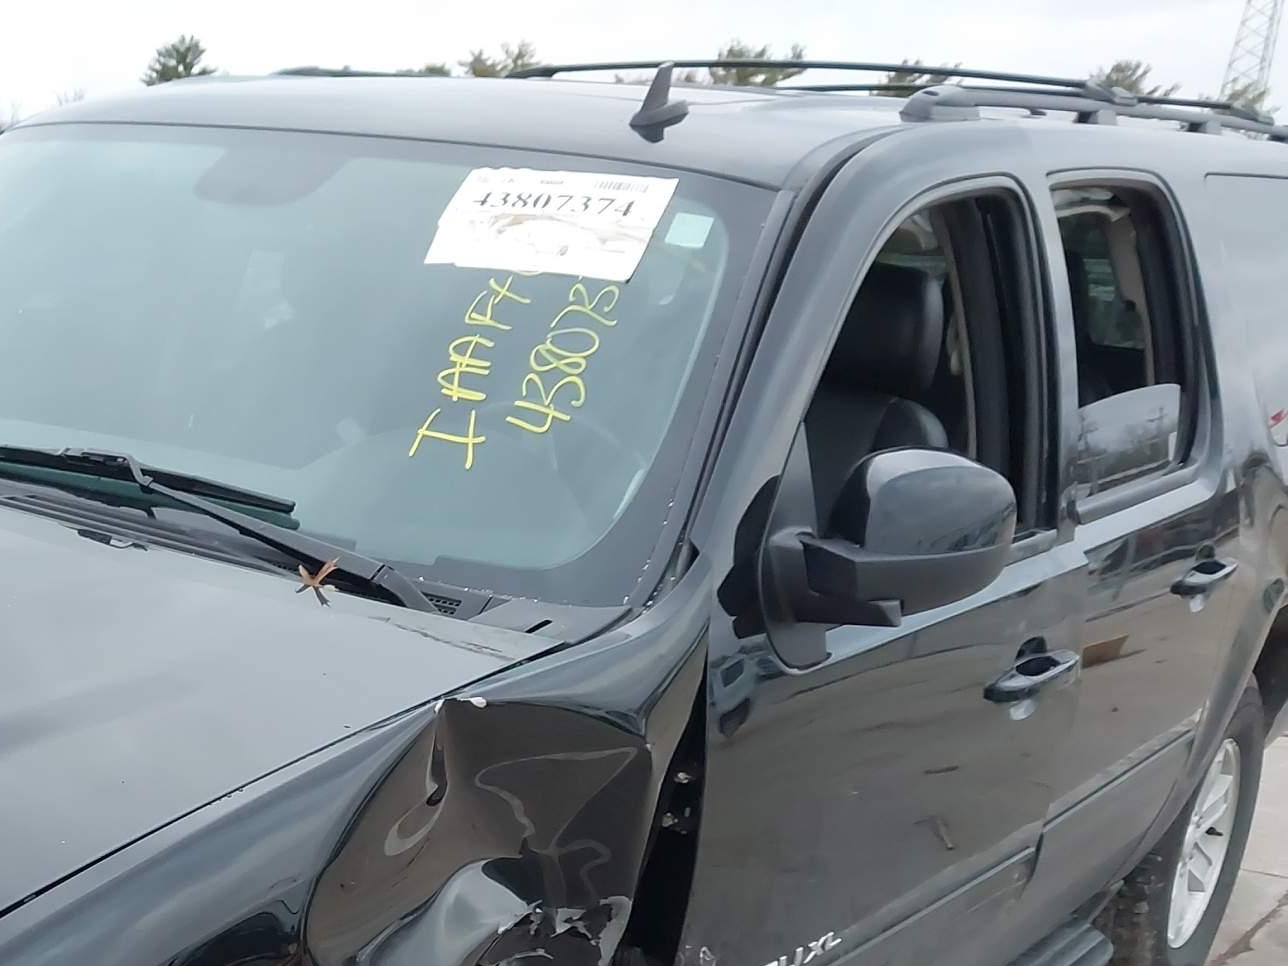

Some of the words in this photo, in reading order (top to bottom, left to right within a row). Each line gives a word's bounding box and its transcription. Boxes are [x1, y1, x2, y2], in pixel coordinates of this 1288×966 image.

[472, 190, 636, 218] 43807374
[505, 276, 620, 434] 438073
[803, 931, 843, 964] XL
